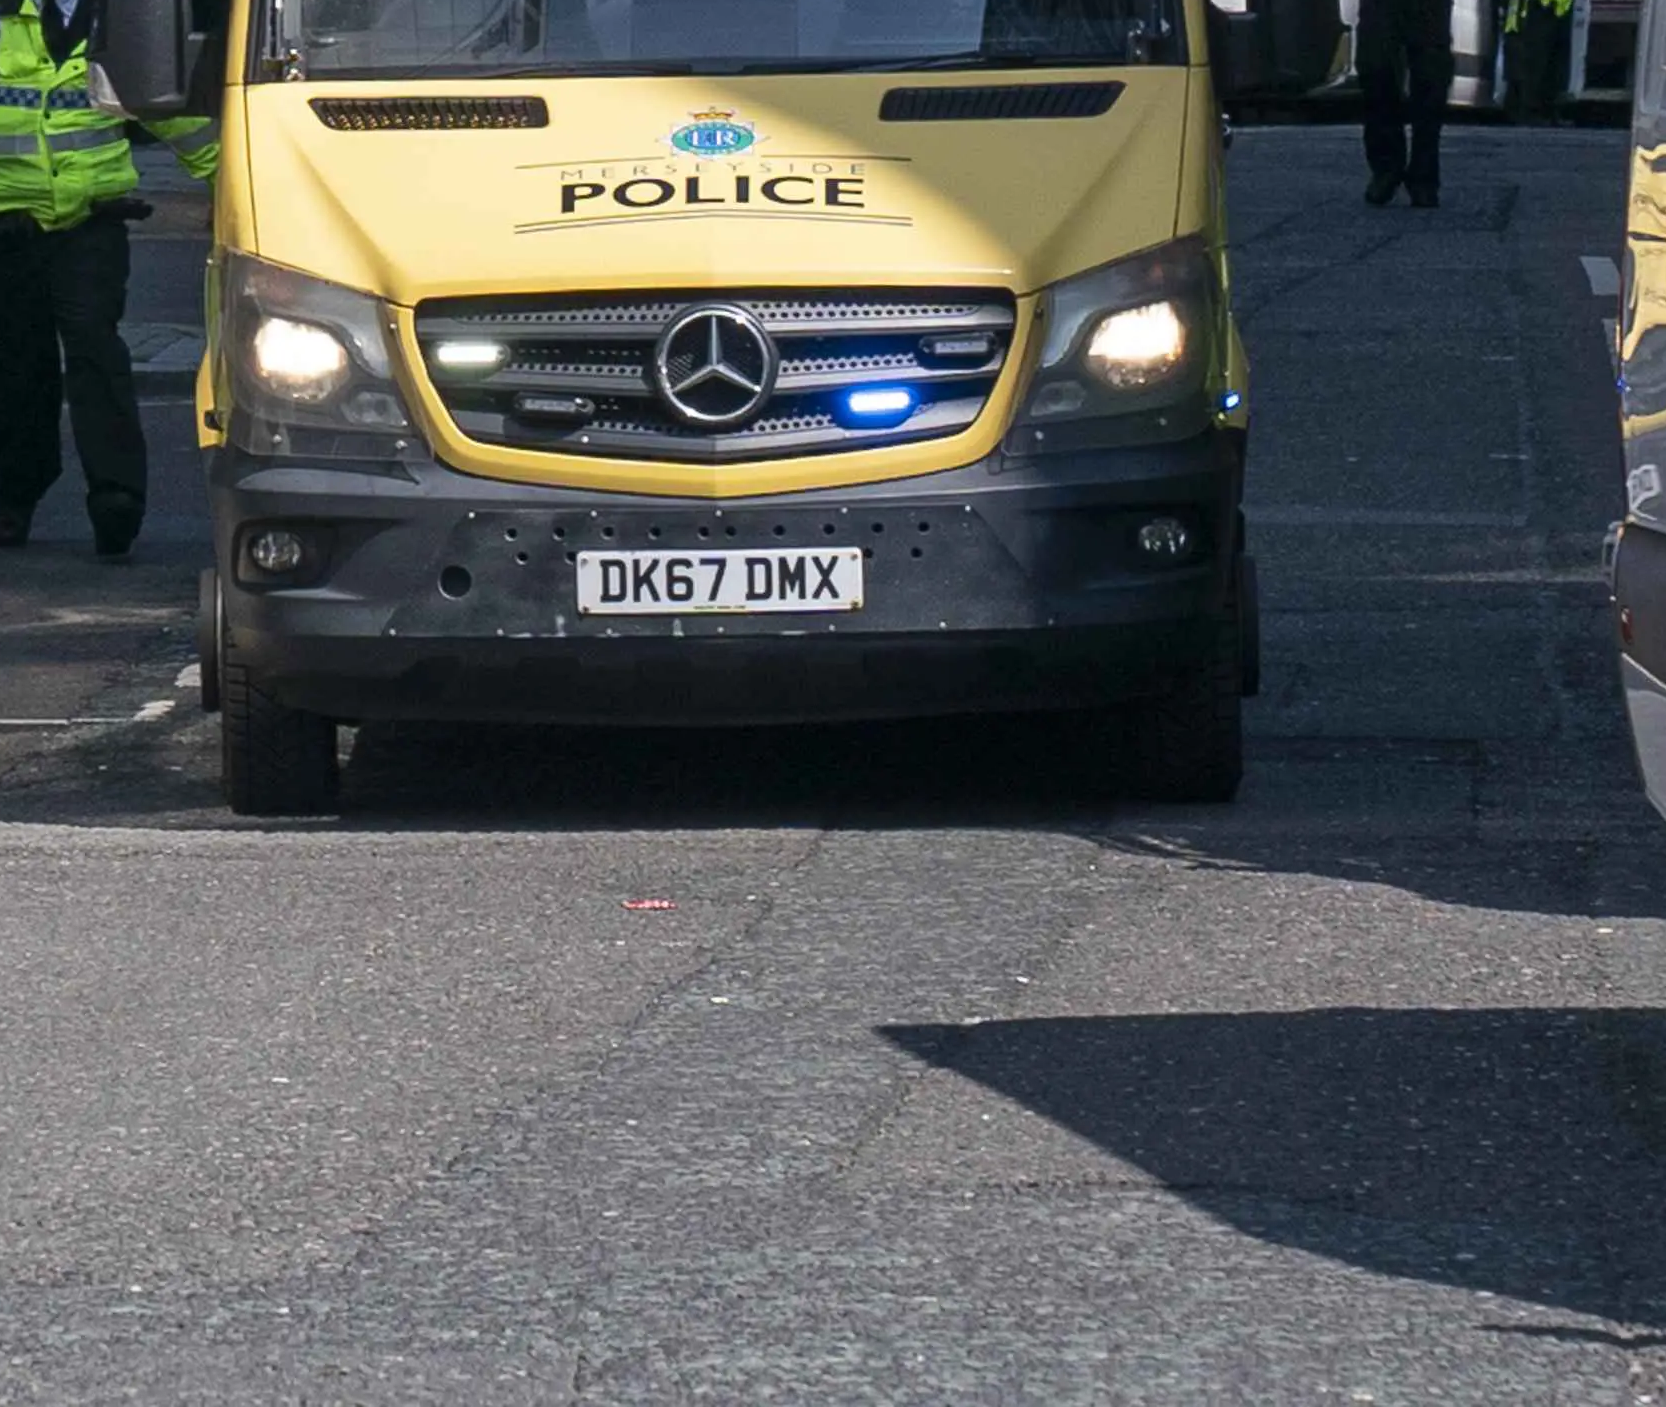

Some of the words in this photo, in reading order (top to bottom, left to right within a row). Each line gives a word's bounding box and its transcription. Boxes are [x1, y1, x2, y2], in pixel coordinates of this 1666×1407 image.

[560, 162, 866, 181] MERSEYSIDE
[560, 174, 866, 214] POLICE
[599, 557, 728, 603] DK67
[744, 555, 840, 601] DMX
